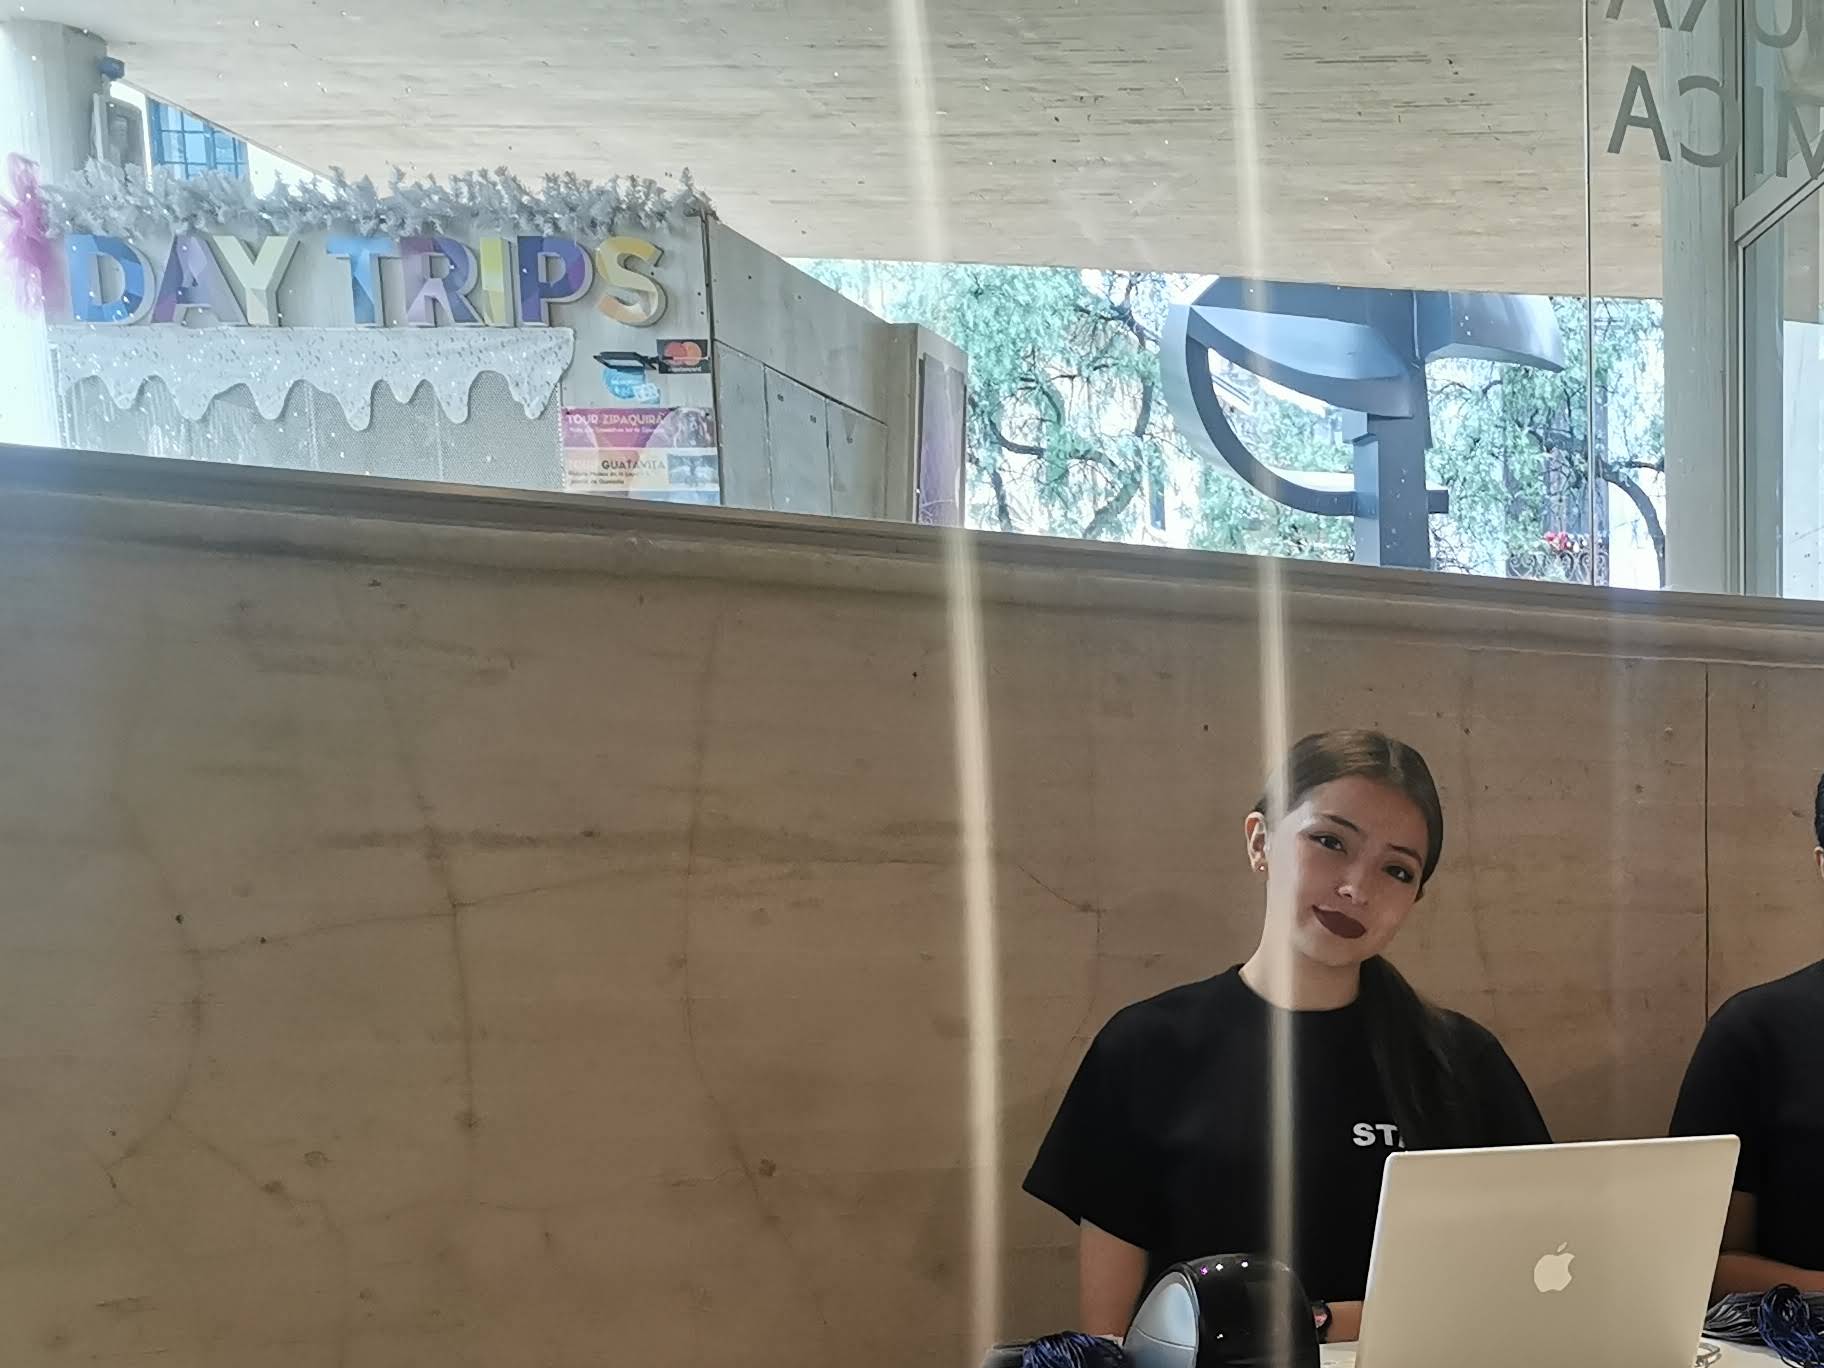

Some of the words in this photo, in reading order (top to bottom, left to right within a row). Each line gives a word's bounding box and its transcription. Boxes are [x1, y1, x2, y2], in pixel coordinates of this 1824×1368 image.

[65, 235, 300, 327] DAY
[326, 235, 668, 328] TRIPS
[567, 413, 599, 425] TOUR
[601, 459, 666, 470] GUATAVITA
